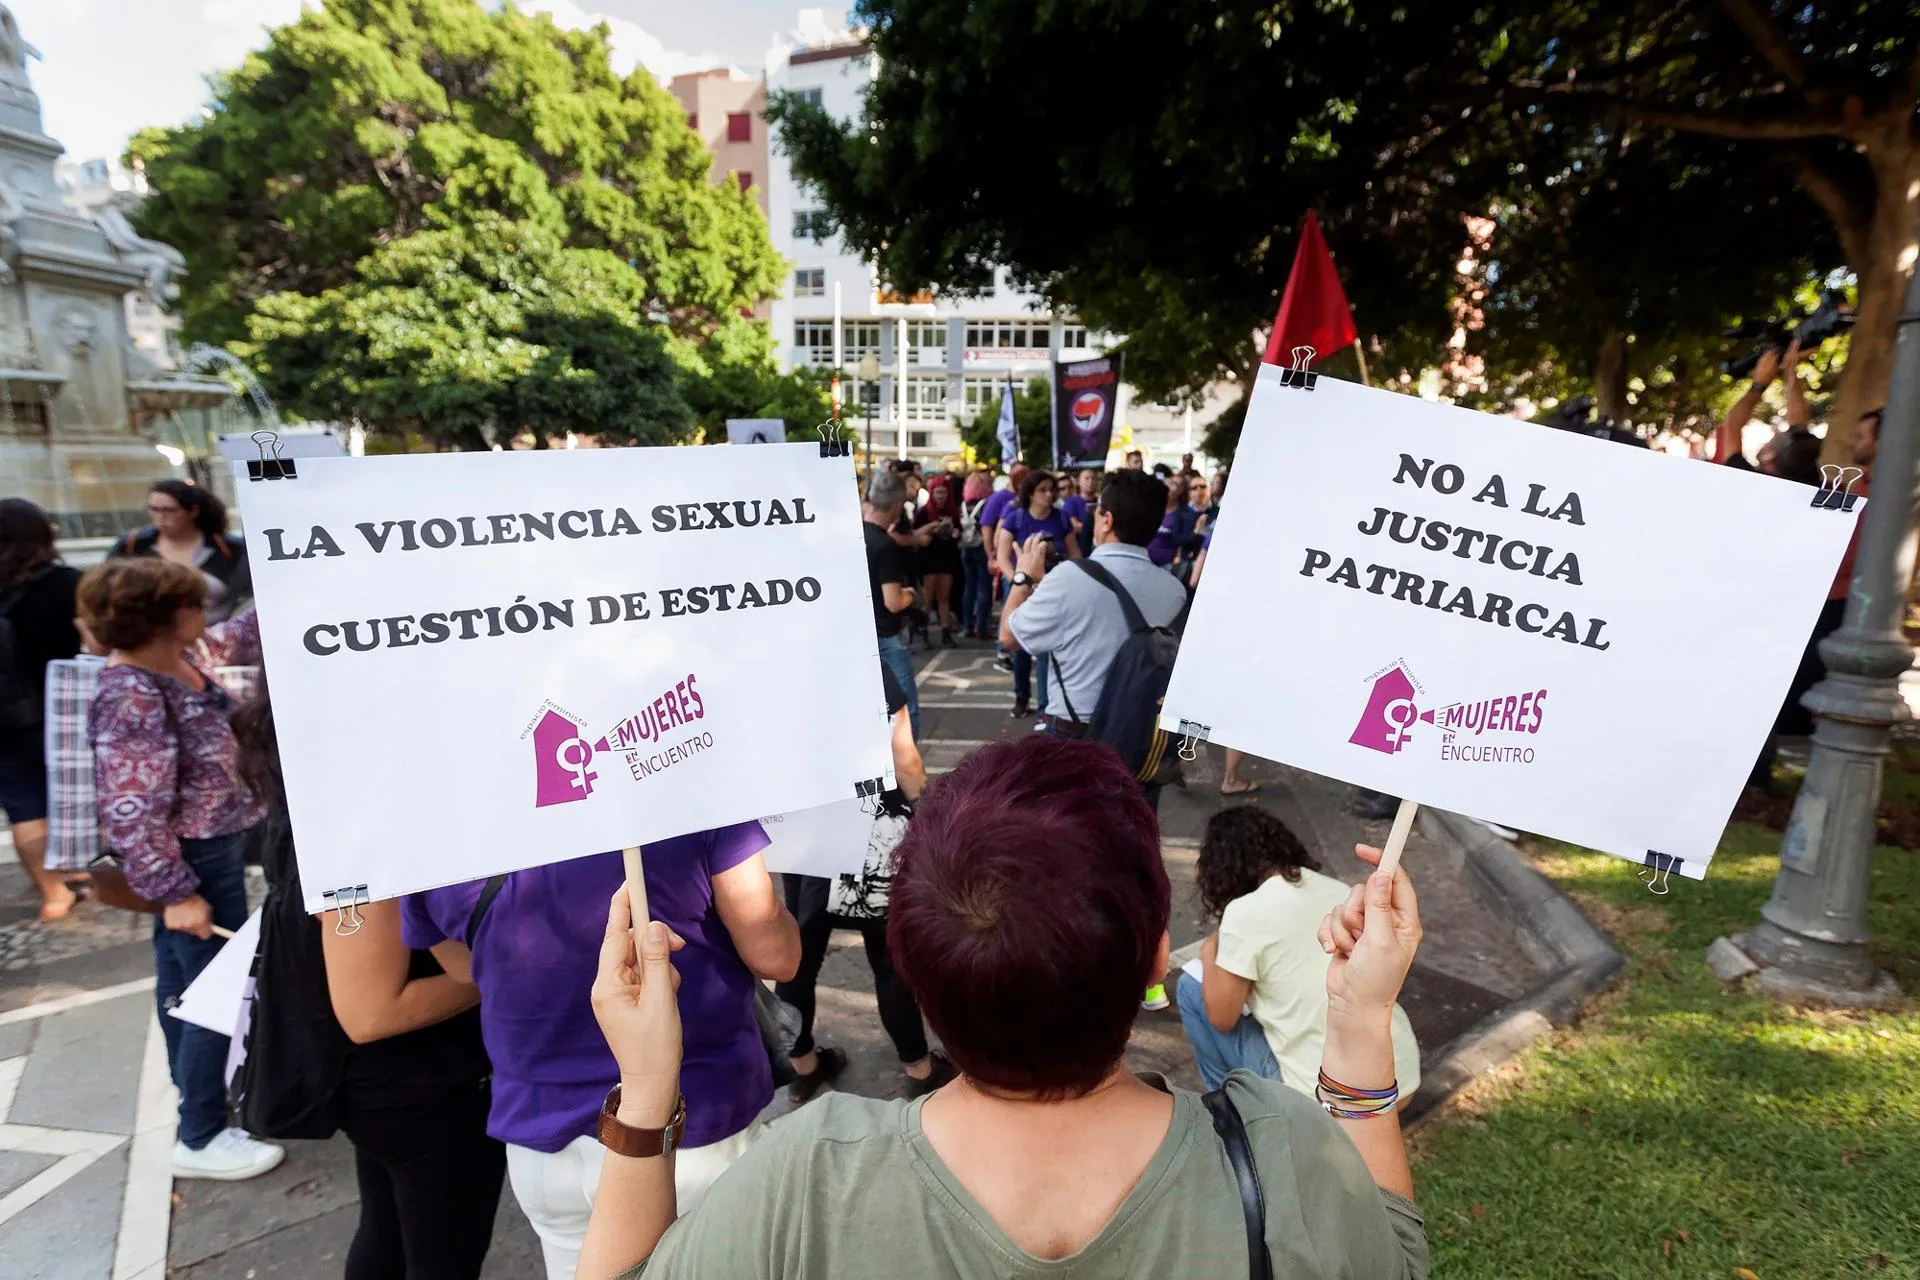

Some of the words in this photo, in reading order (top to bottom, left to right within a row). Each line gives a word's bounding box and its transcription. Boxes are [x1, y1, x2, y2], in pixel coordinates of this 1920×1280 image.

[1392, 453, 1465, 495] NO
[1471, 474, 1509, 509] A
[1520, 483, 1586, 526] LA
[262, 525, 346, 561] LA
[354, 507, 643, 554] VIOLENCIA
[651, 497, 816, 533] SEXUAL
[1357, 507, 1584, 586] JUSTICIA
[302, 594, 575, 657] CUESTIÓN
[586, 591, 651, 626] DE
[658, 576, 823, 618] ESTADO
[1298, 547, 1611, 651] PATRIARCAL
[1363, 660, 1398, 684] espacio
[1397, 656, 1426, 696] feminista
[519, 704, 547, 741] espacio
[543, 698, 589, 729] feminista
[616, 673, 705, 748] MUJERES
[1444, 689, 1548, 736] MUJERES
[625, 751, 640, 765] EN
[630, 731, 714, 782] ENCUENTRO
[1441, 745, 1535, 764] ENCUENTRO
[758, 815, 784, 825] ENTRO
